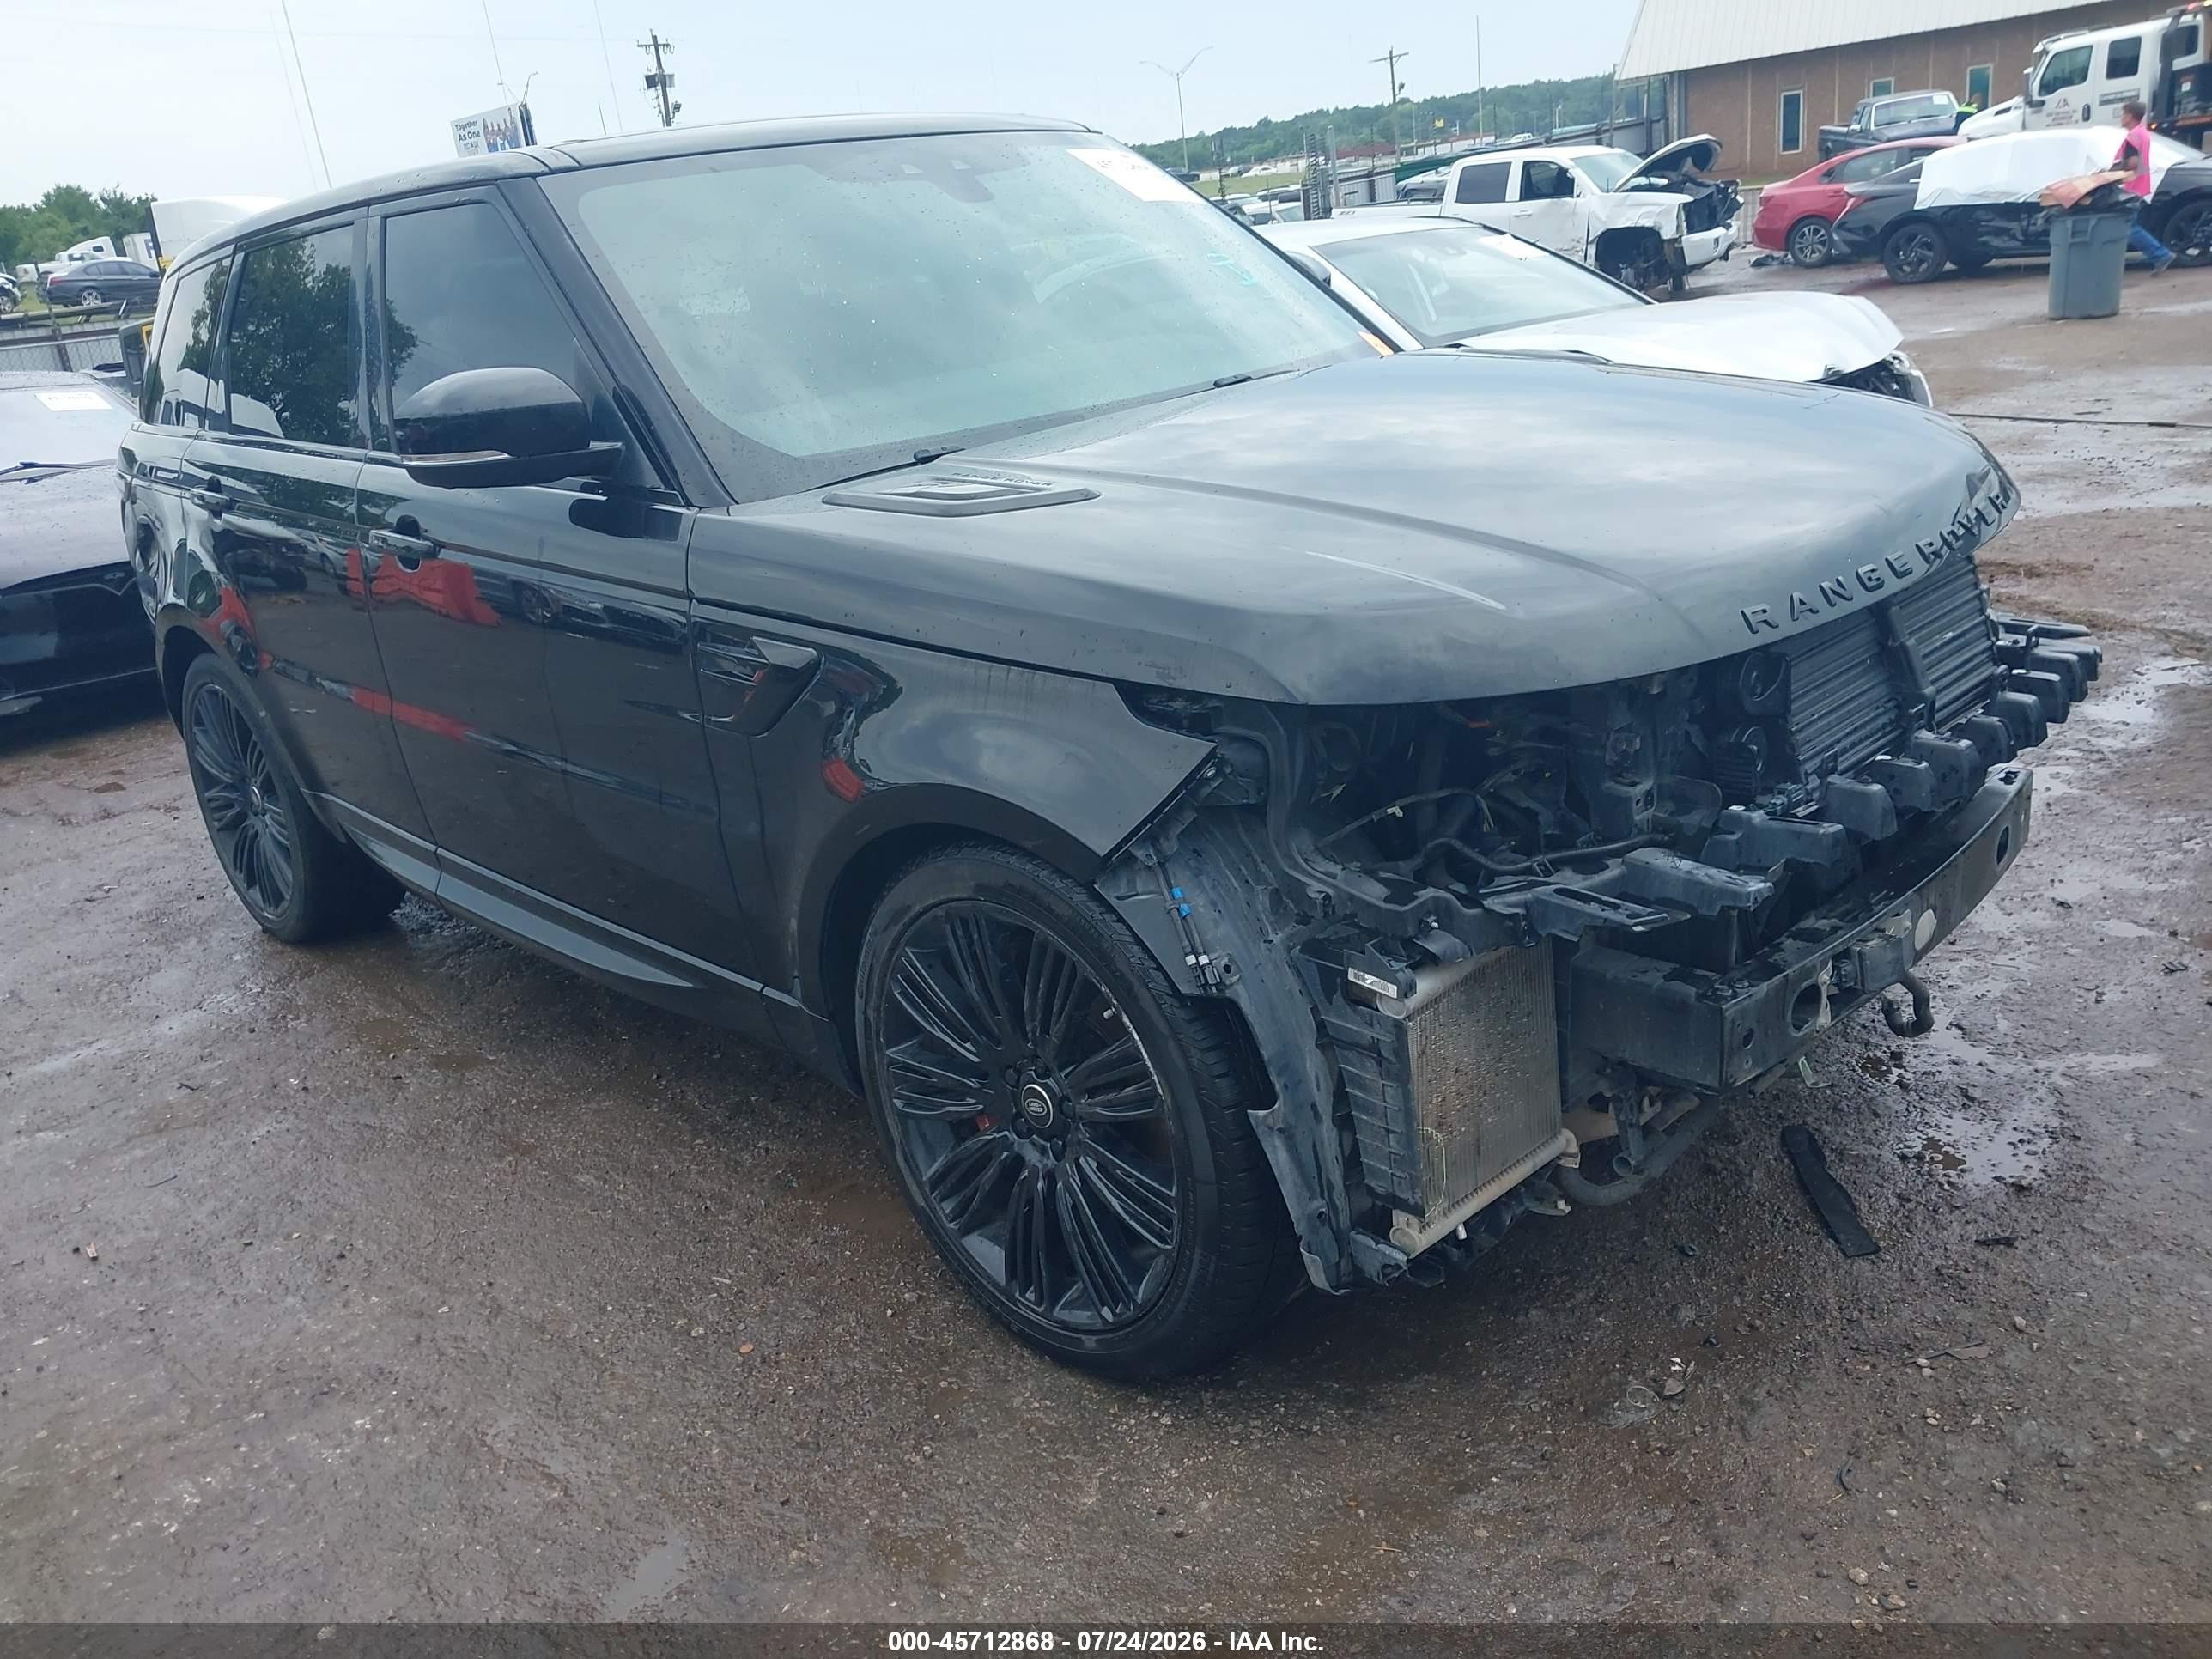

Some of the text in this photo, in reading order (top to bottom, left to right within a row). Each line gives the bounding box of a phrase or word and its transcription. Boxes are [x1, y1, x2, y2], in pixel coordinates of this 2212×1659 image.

[455, 120, 477, 131] Together
[459, 130, 481, 142] As One
[1739, 550, 1914, 635] RANGE
